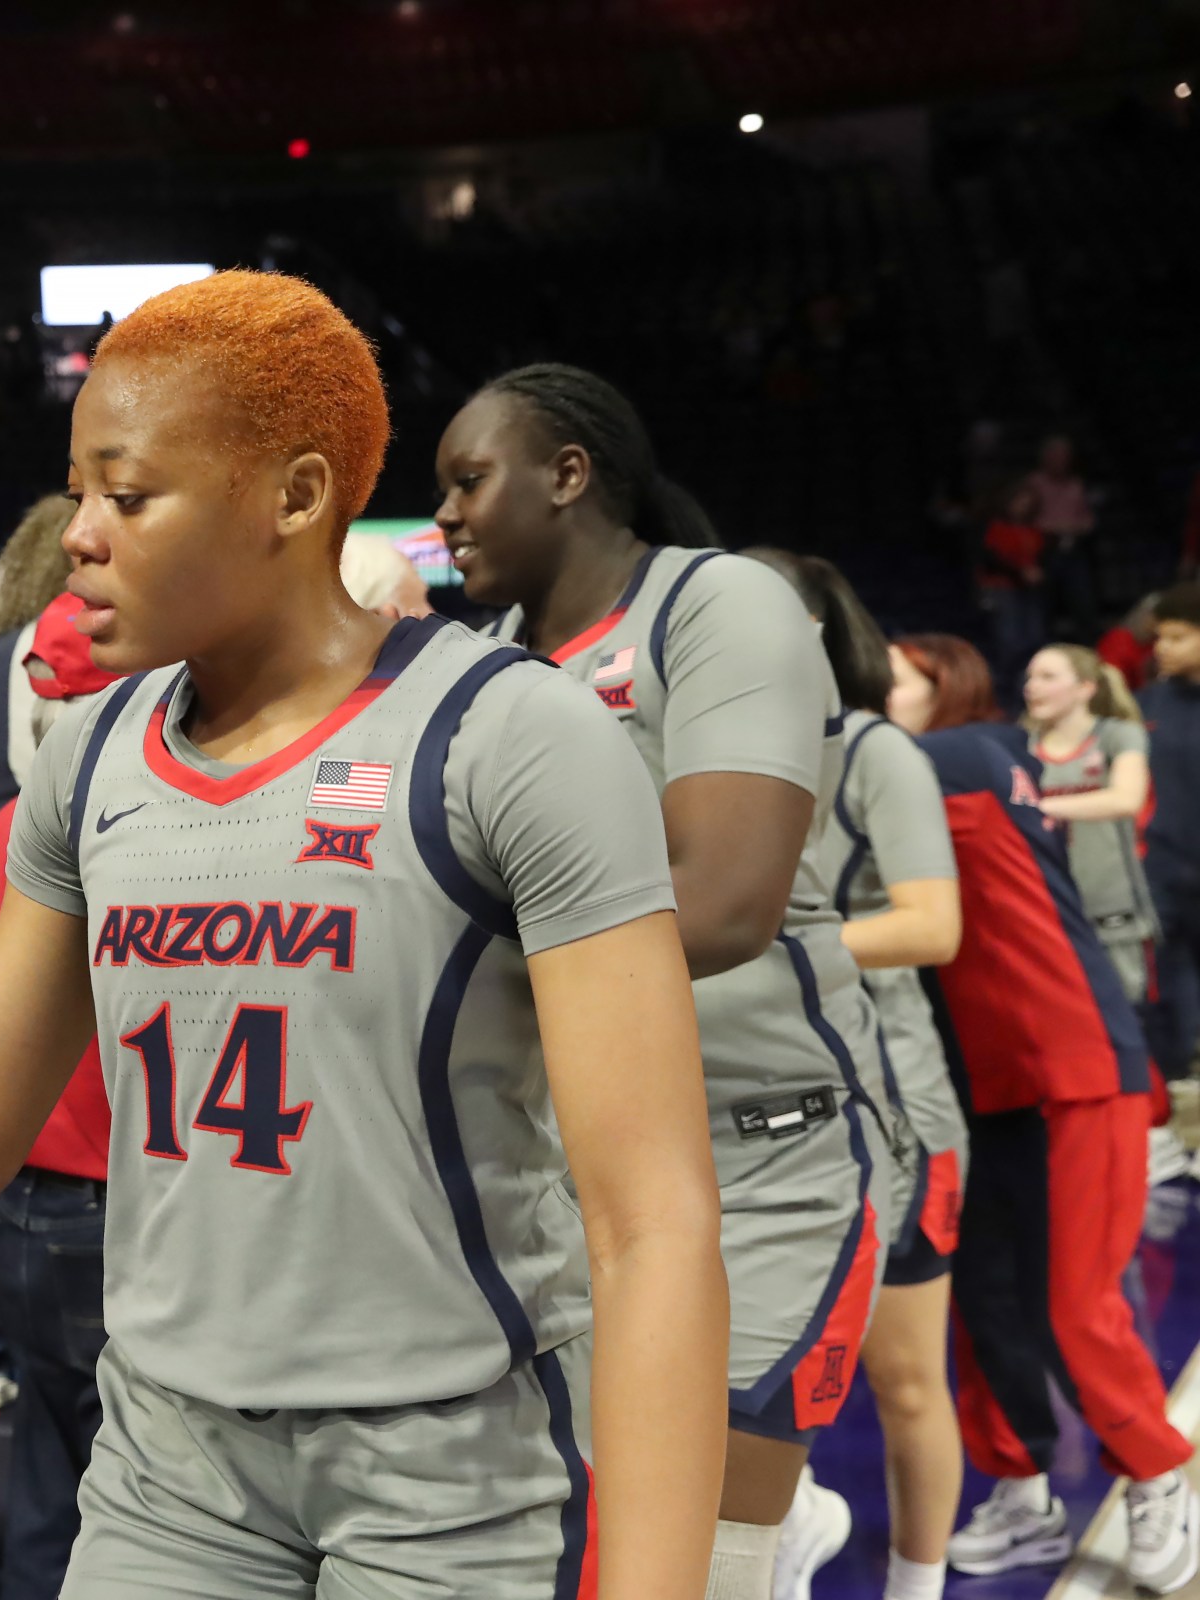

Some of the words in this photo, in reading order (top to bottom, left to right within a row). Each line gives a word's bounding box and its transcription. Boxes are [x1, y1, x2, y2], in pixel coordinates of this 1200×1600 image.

[302, 822, 376, 866] XII
[93, 901, 357, 973] ARIZONA
[119, 1001, 314, 1176] 14
